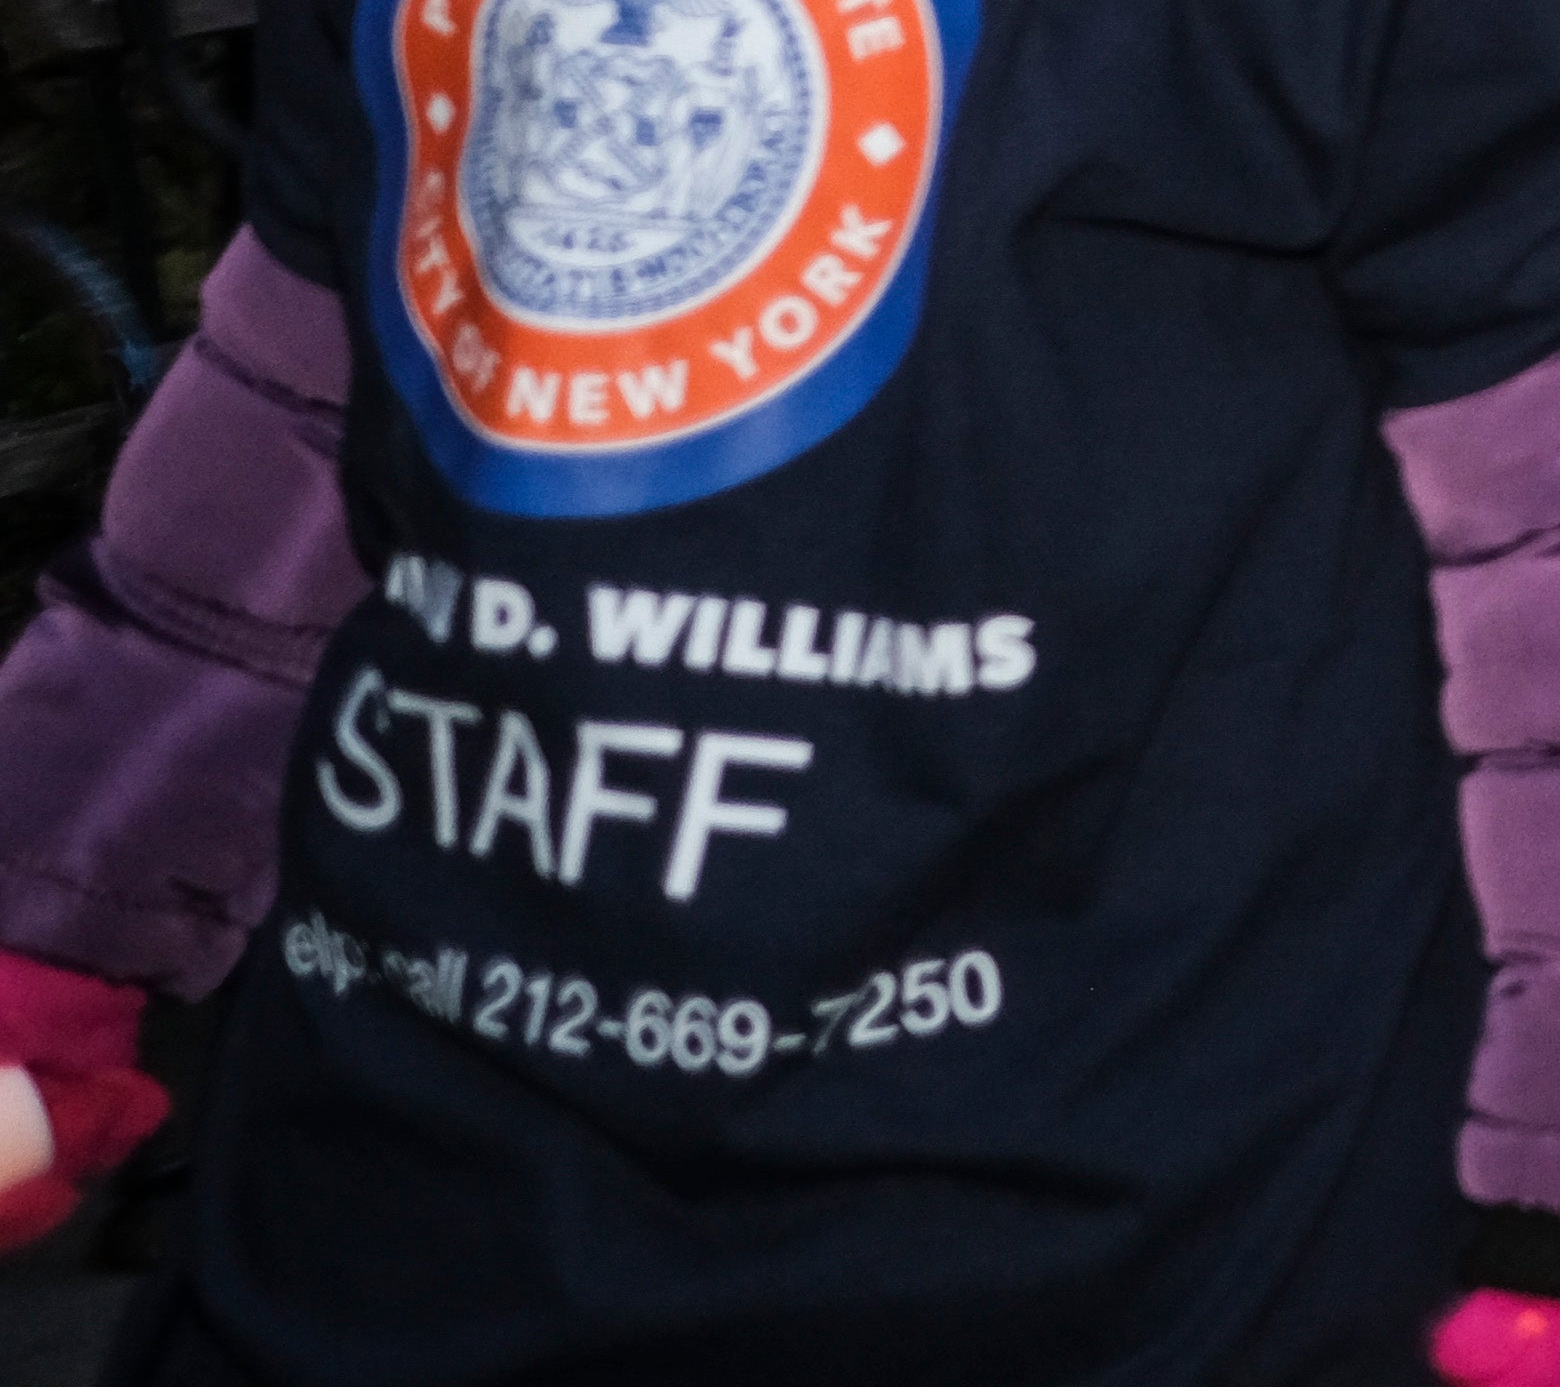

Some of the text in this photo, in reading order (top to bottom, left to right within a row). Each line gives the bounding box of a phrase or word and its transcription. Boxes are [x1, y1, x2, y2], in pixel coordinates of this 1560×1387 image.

[507, 358, 690, 424] NEW
[709, 203, 892, 380] YORK
[472, 577, 560, 659] D.
[587, 582, 1037, 697] WILLIAMS
[316, 667, 814, 903] STAFF
[472, 950, 1002, 1077] 212-669-7250
